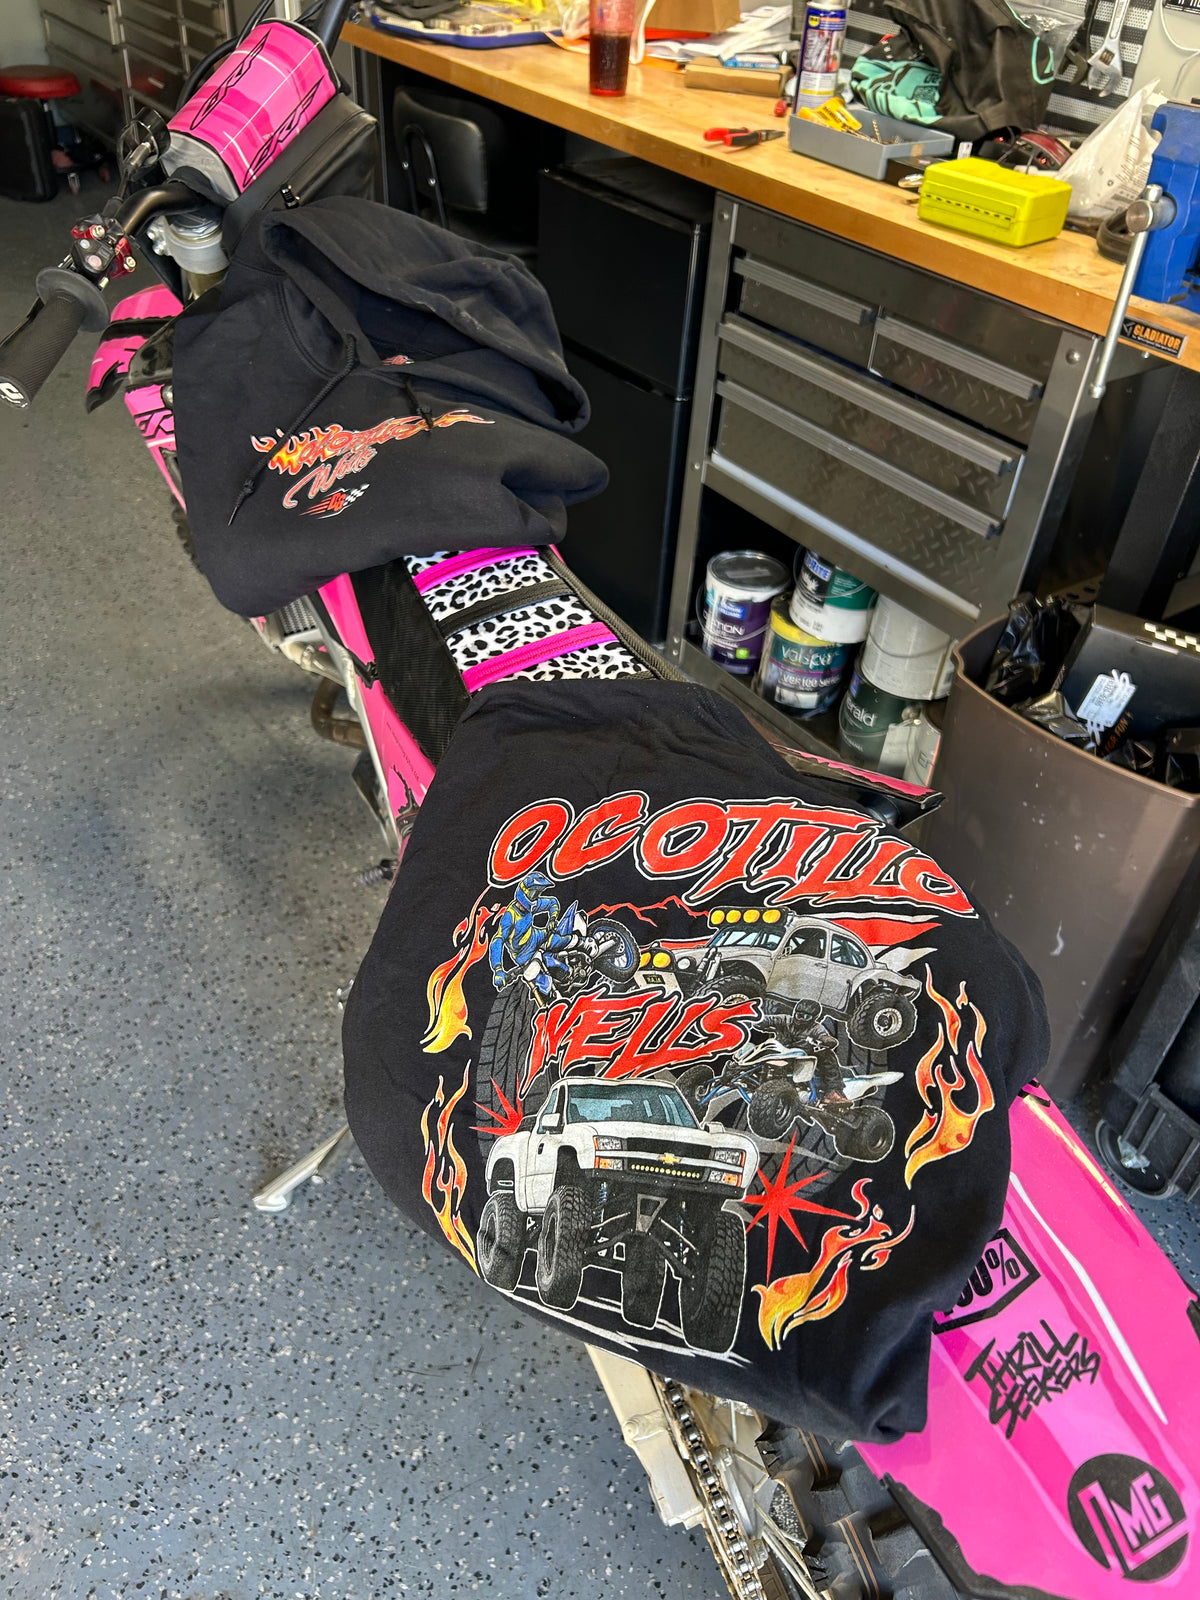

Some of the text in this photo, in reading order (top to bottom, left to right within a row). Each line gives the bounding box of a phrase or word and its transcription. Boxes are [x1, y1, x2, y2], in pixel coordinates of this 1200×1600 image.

[1132, 323, 1181, 350] GLADIATOR
[488, 790, 980, 919] OCOTILLO
[518, 984, 764, 1099] WELLS
[988, 1337, 1101, 1440] SEEKERS
